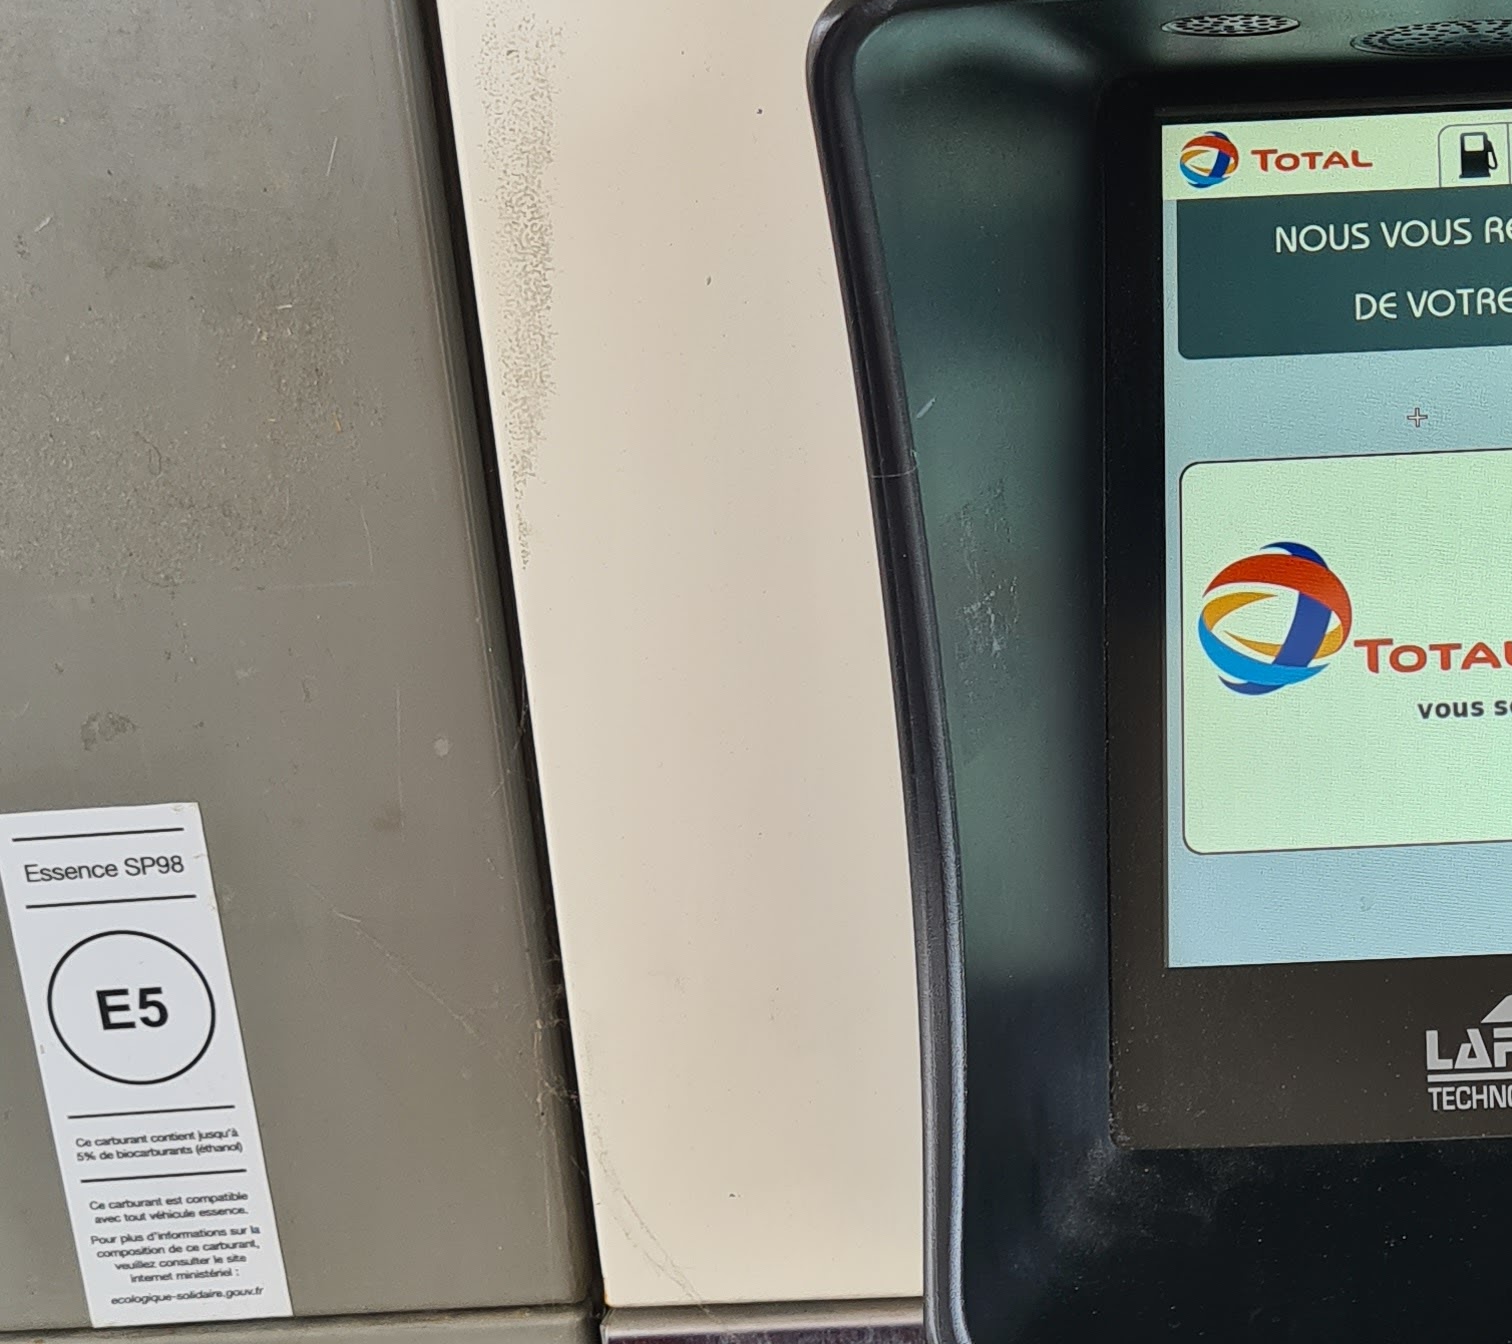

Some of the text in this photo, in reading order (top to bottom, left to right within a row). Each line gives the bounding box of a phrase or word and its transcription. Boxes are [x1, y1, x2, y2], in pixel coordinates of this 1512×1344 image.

[1275, 221, 1371, 256] NOUS
[1379, 217, 1473, 249] VOUS
[1355, 292, 1397, 321] DE
[1417, 695, 1485, 719] vous
[24, 855, 185, 883] Essence SP98
[96, 986, 169, 1031] E5
[75, 1138, 92, 1148] Ce
[95, 1134, 148, 1146] carburant
[150, 1131, 195, 1143] contient
[76, 1151, 96, 1161] 5%
[100, 1149, 114, 1160] de
[116, 1145, 193, 1159] biocarburants
[89, 1192, 248, 1210] Ce carburant est compatible
[95, 1206, 248, 1224] avec tout véhicule essence.
[91, 1234, 117, 1244] Pour
[120, 1232, 144, 1245] plus
[230, 1226, 247, 1235] sur
[250, 1225, 260, 1234] la
[97, 1245, 166, 1258] composition
[169, 1243, 183, 1253] de
[186, 1244, 200, 1252] ce
[115, 1253, 247, 1270] veuillez consulter le site
[131, 1271, 173, 1283] internet
